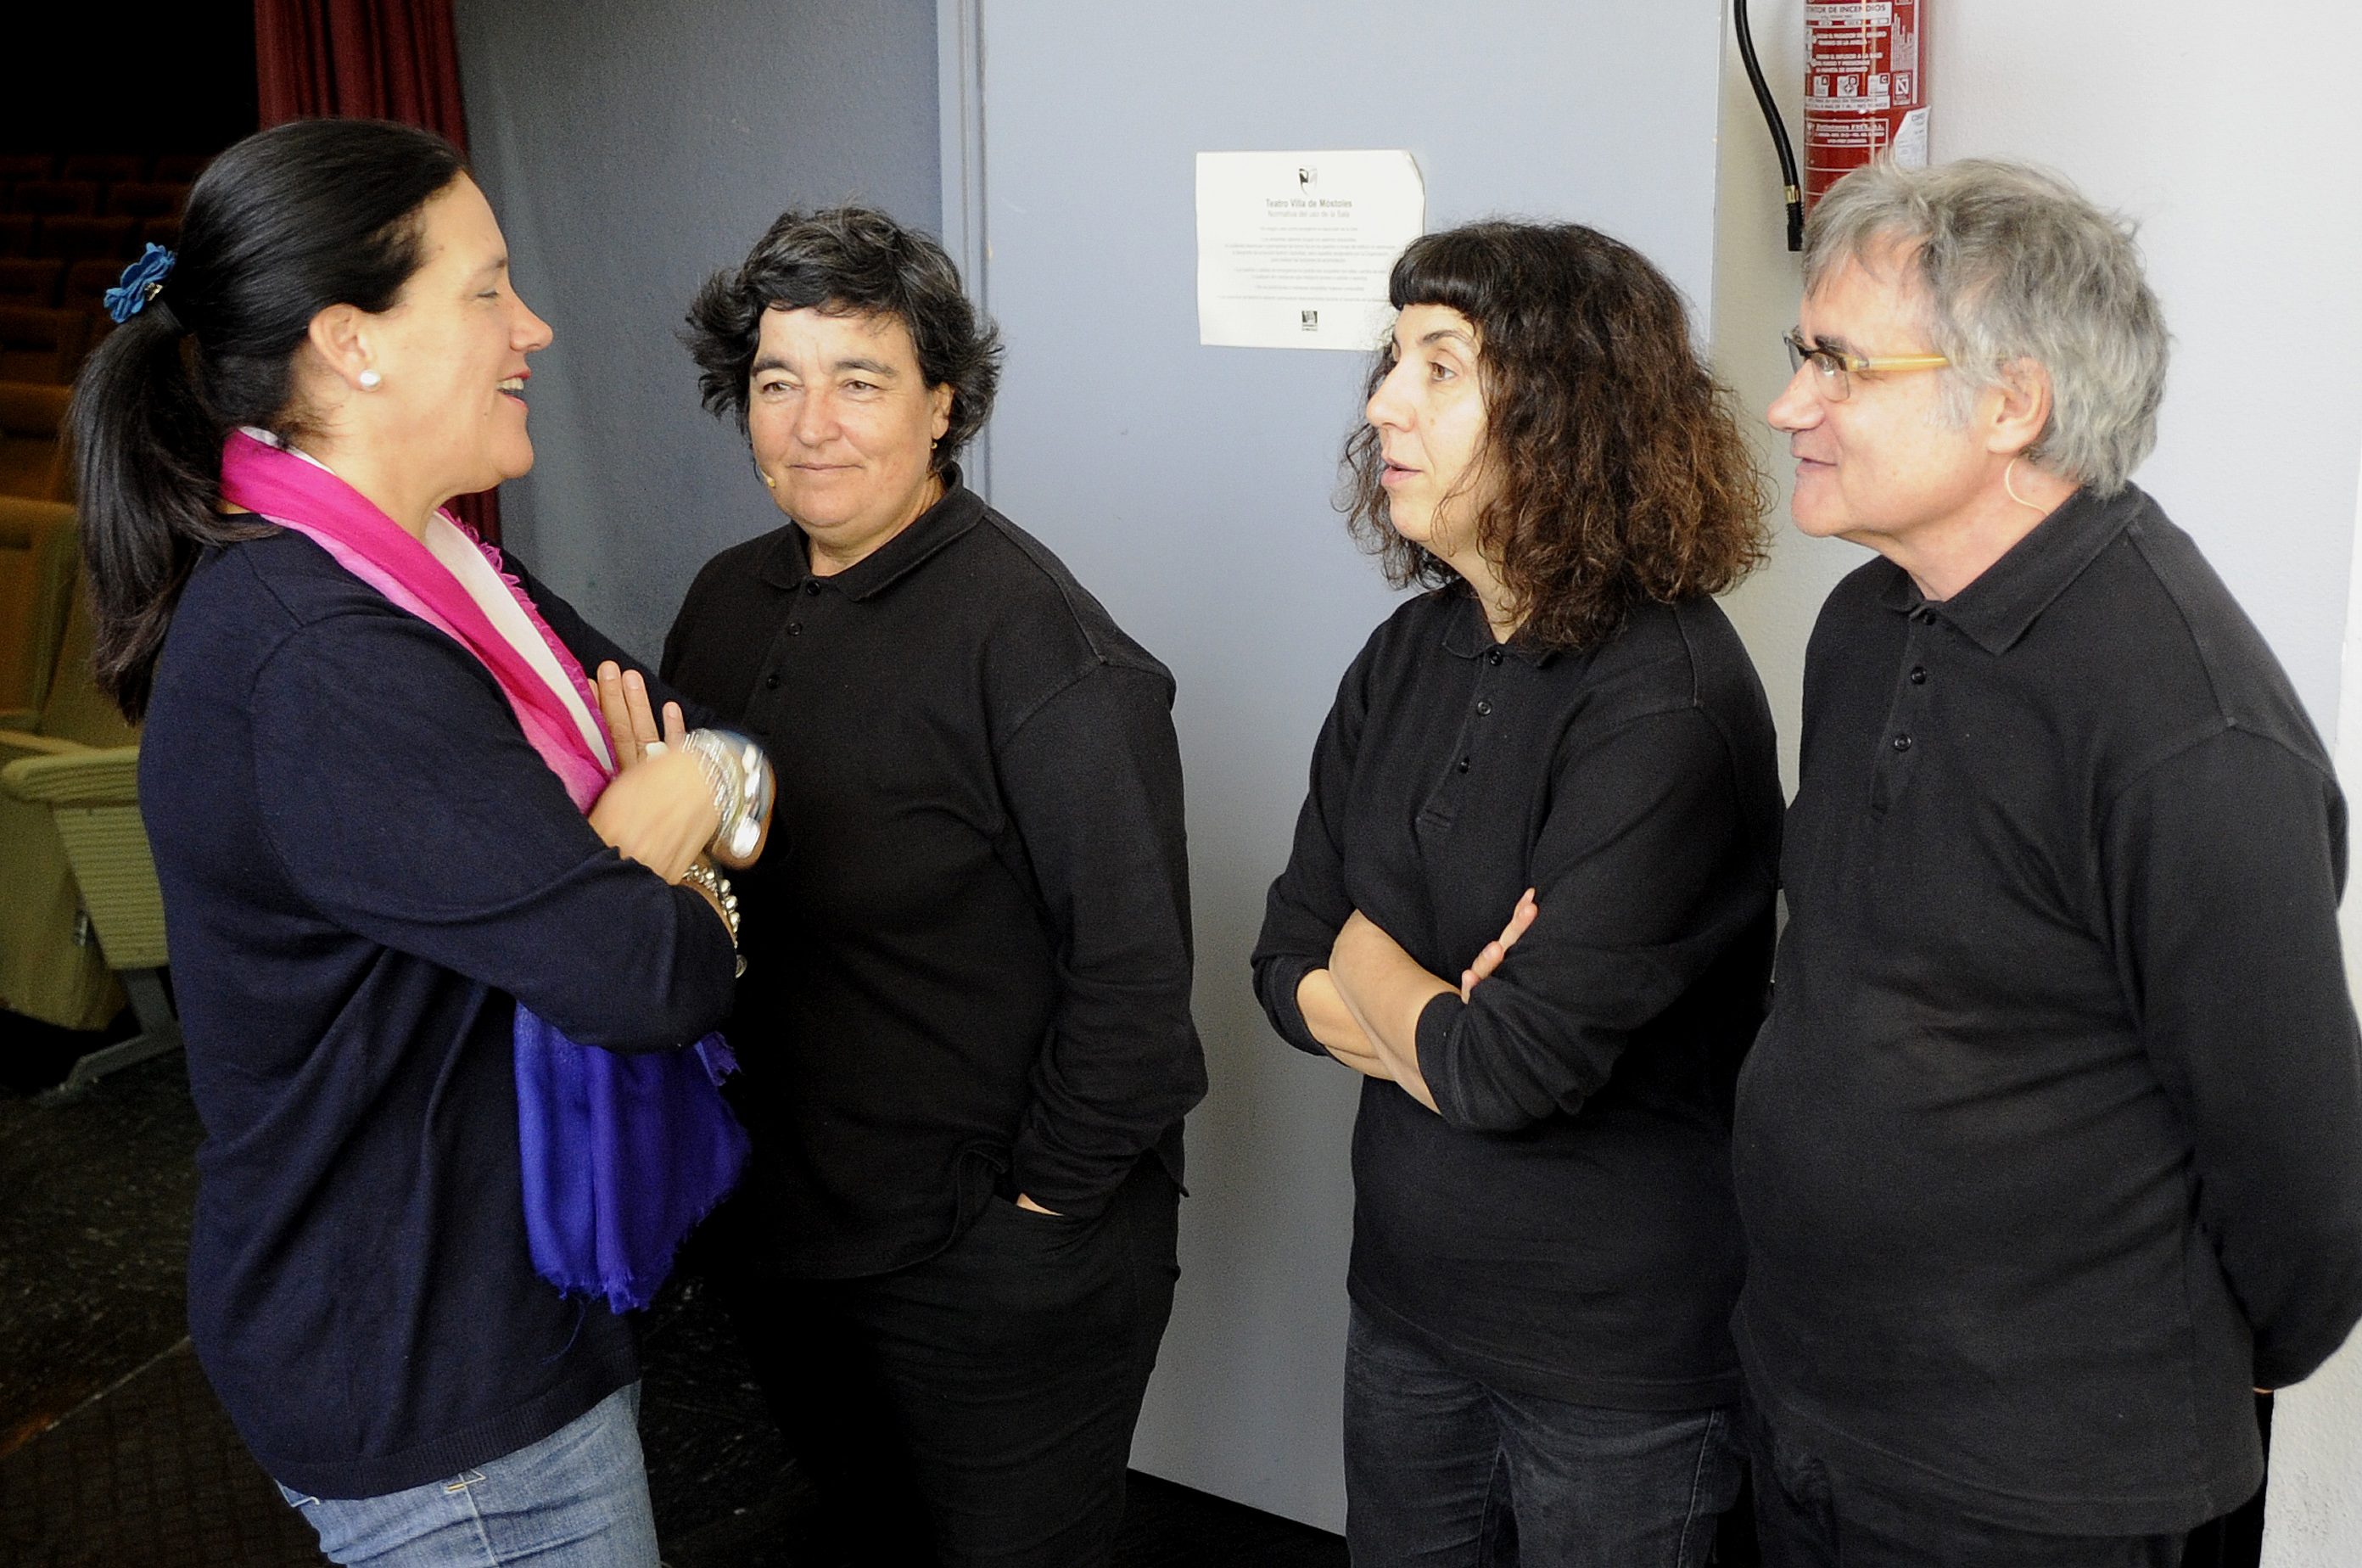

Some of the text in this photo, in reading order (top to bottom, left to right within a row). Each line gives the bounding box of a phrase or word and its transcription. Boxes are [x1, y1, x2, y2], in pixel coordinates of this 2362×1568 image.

[1266, 198, 1289, 208] Teatro
[1290, 198, 1306, 208] Villa
[1307, 199, 1317, 208] de
